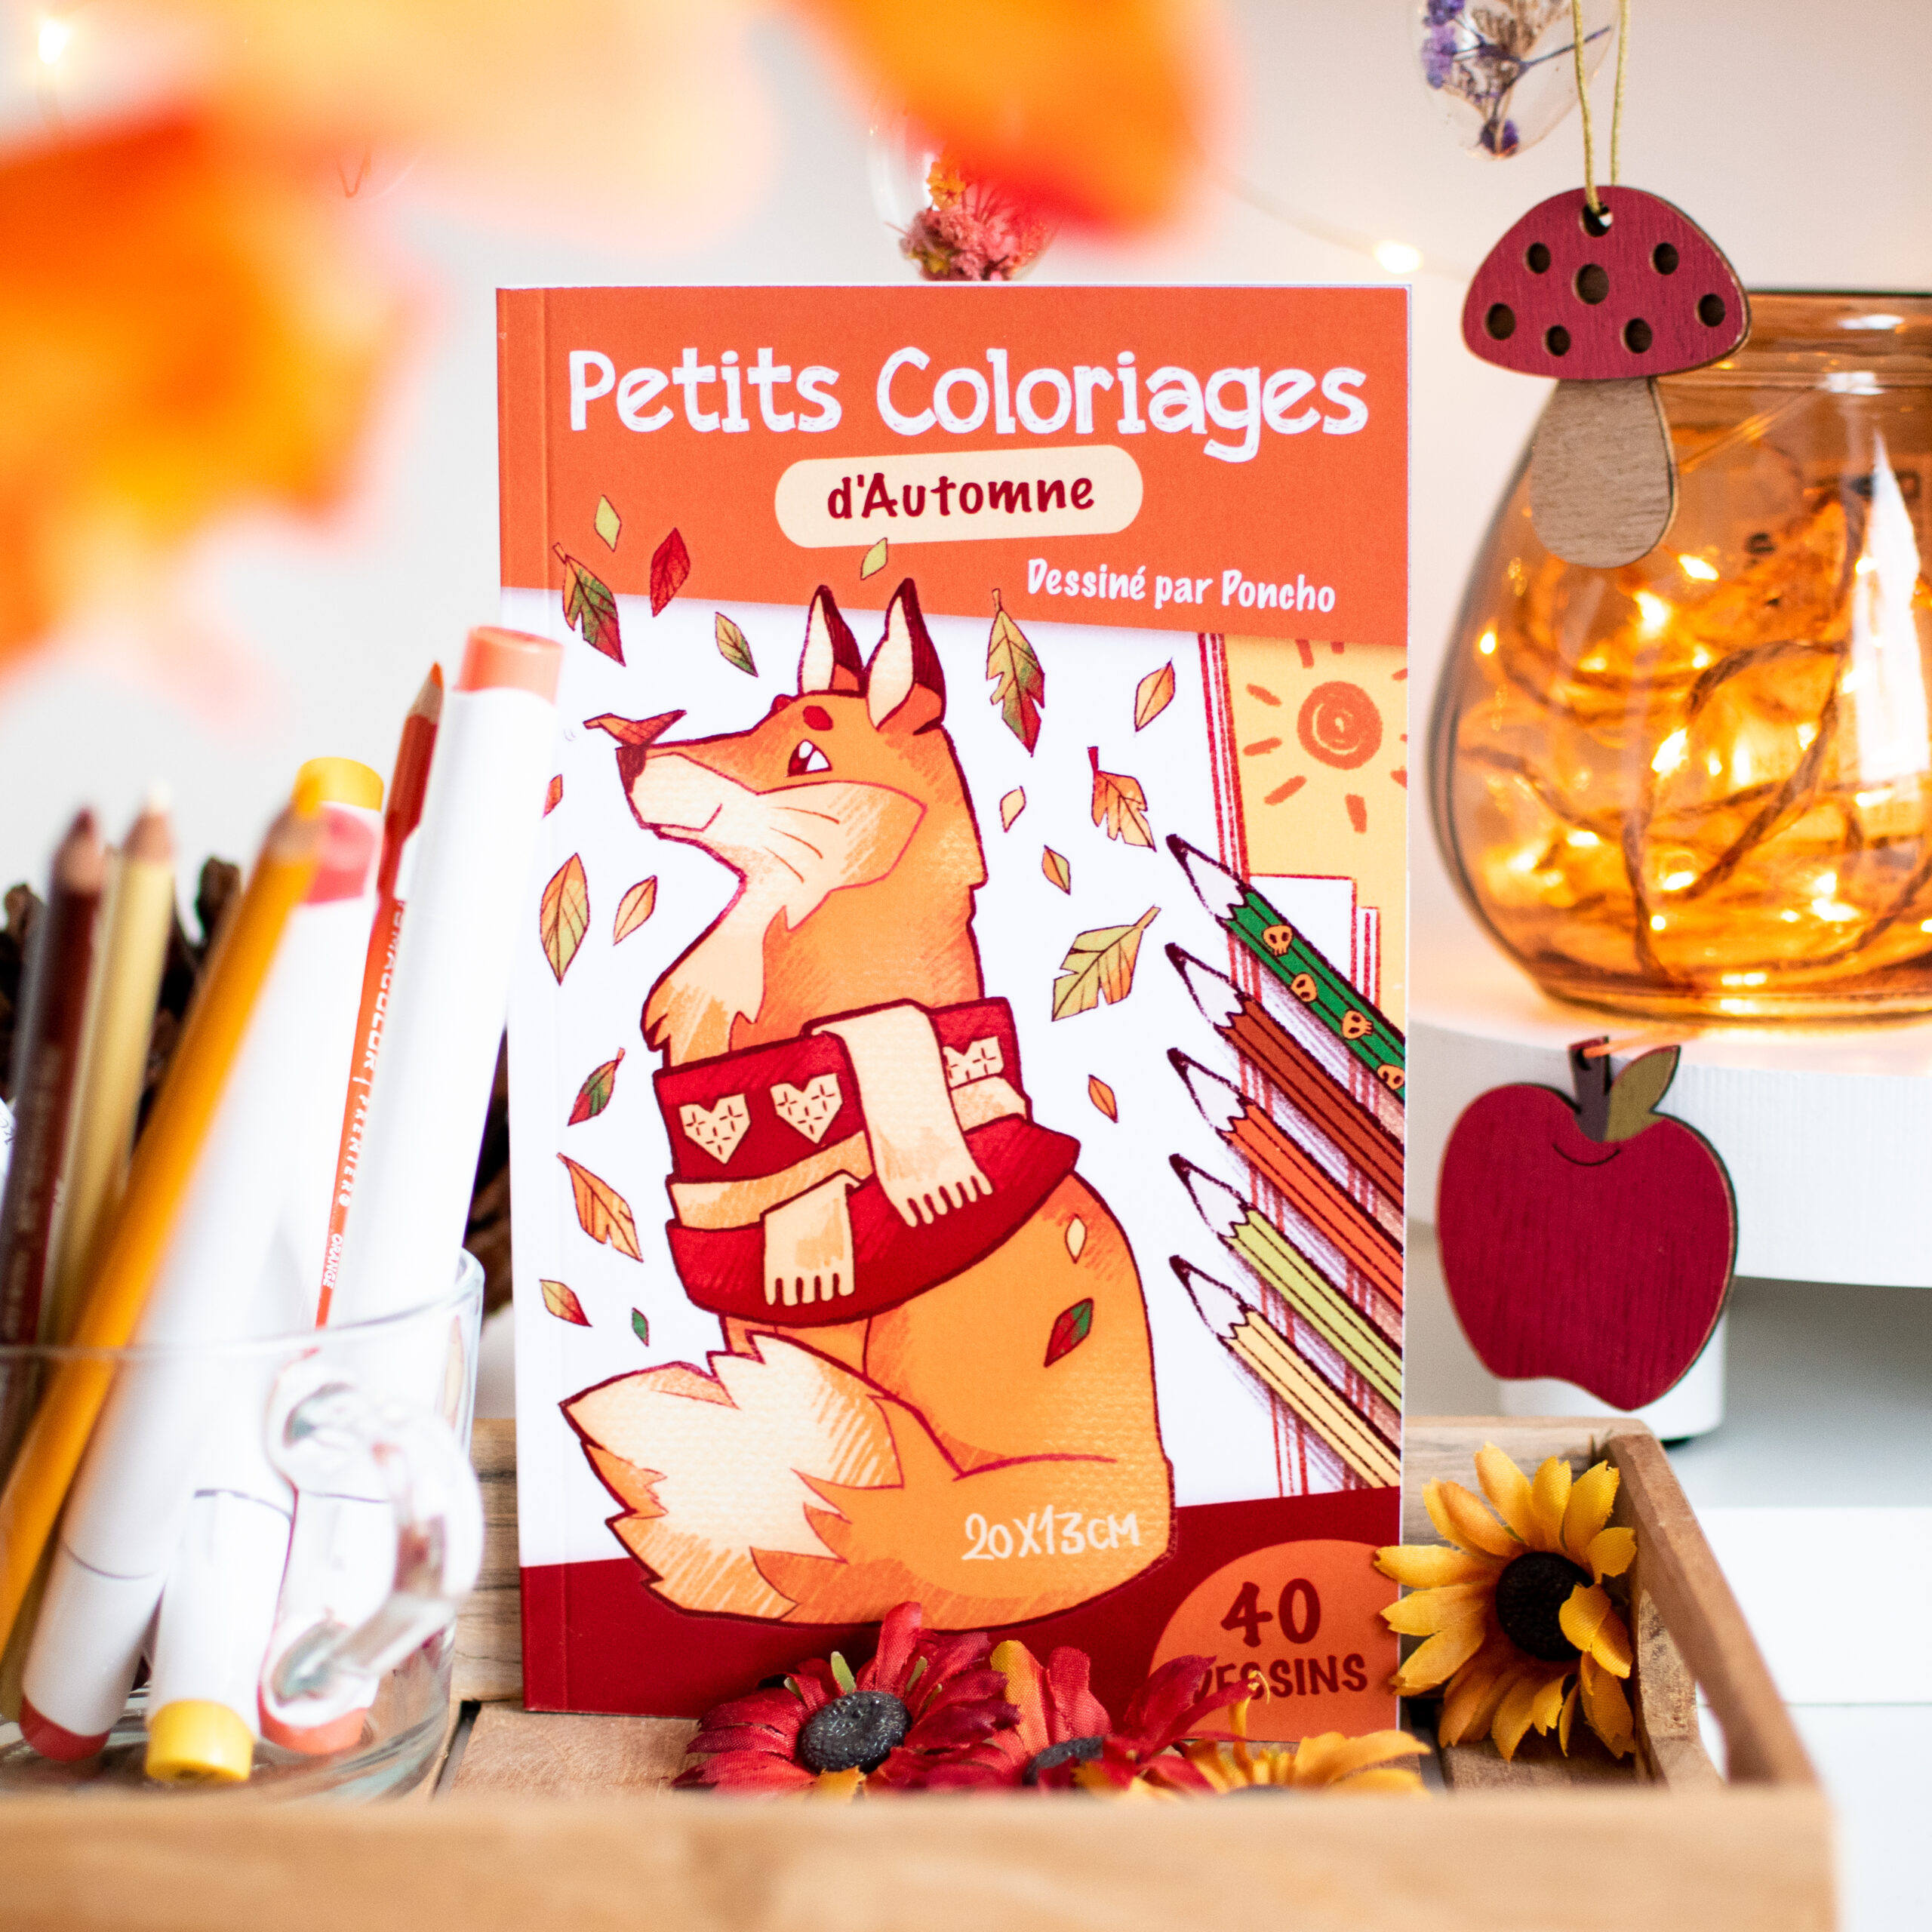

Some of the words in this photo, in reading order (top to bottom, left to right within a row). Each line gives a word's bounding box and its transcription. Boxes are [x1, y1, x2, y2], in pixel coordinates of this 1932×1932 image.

[569, 347, 842, 433] Petits
[876, 346, 1368, 463] Coloriages
[827, 472, 1094, 519] d'Automne
[1027, 558, 1146, 601] Dessiné
[1154, 575, 1213, 610] par
[1221, 569, 1336, 614] Poncho
[322, 1232, 343, 1289] ORANGE
[1220, 1577, 1321, 1647] 40
